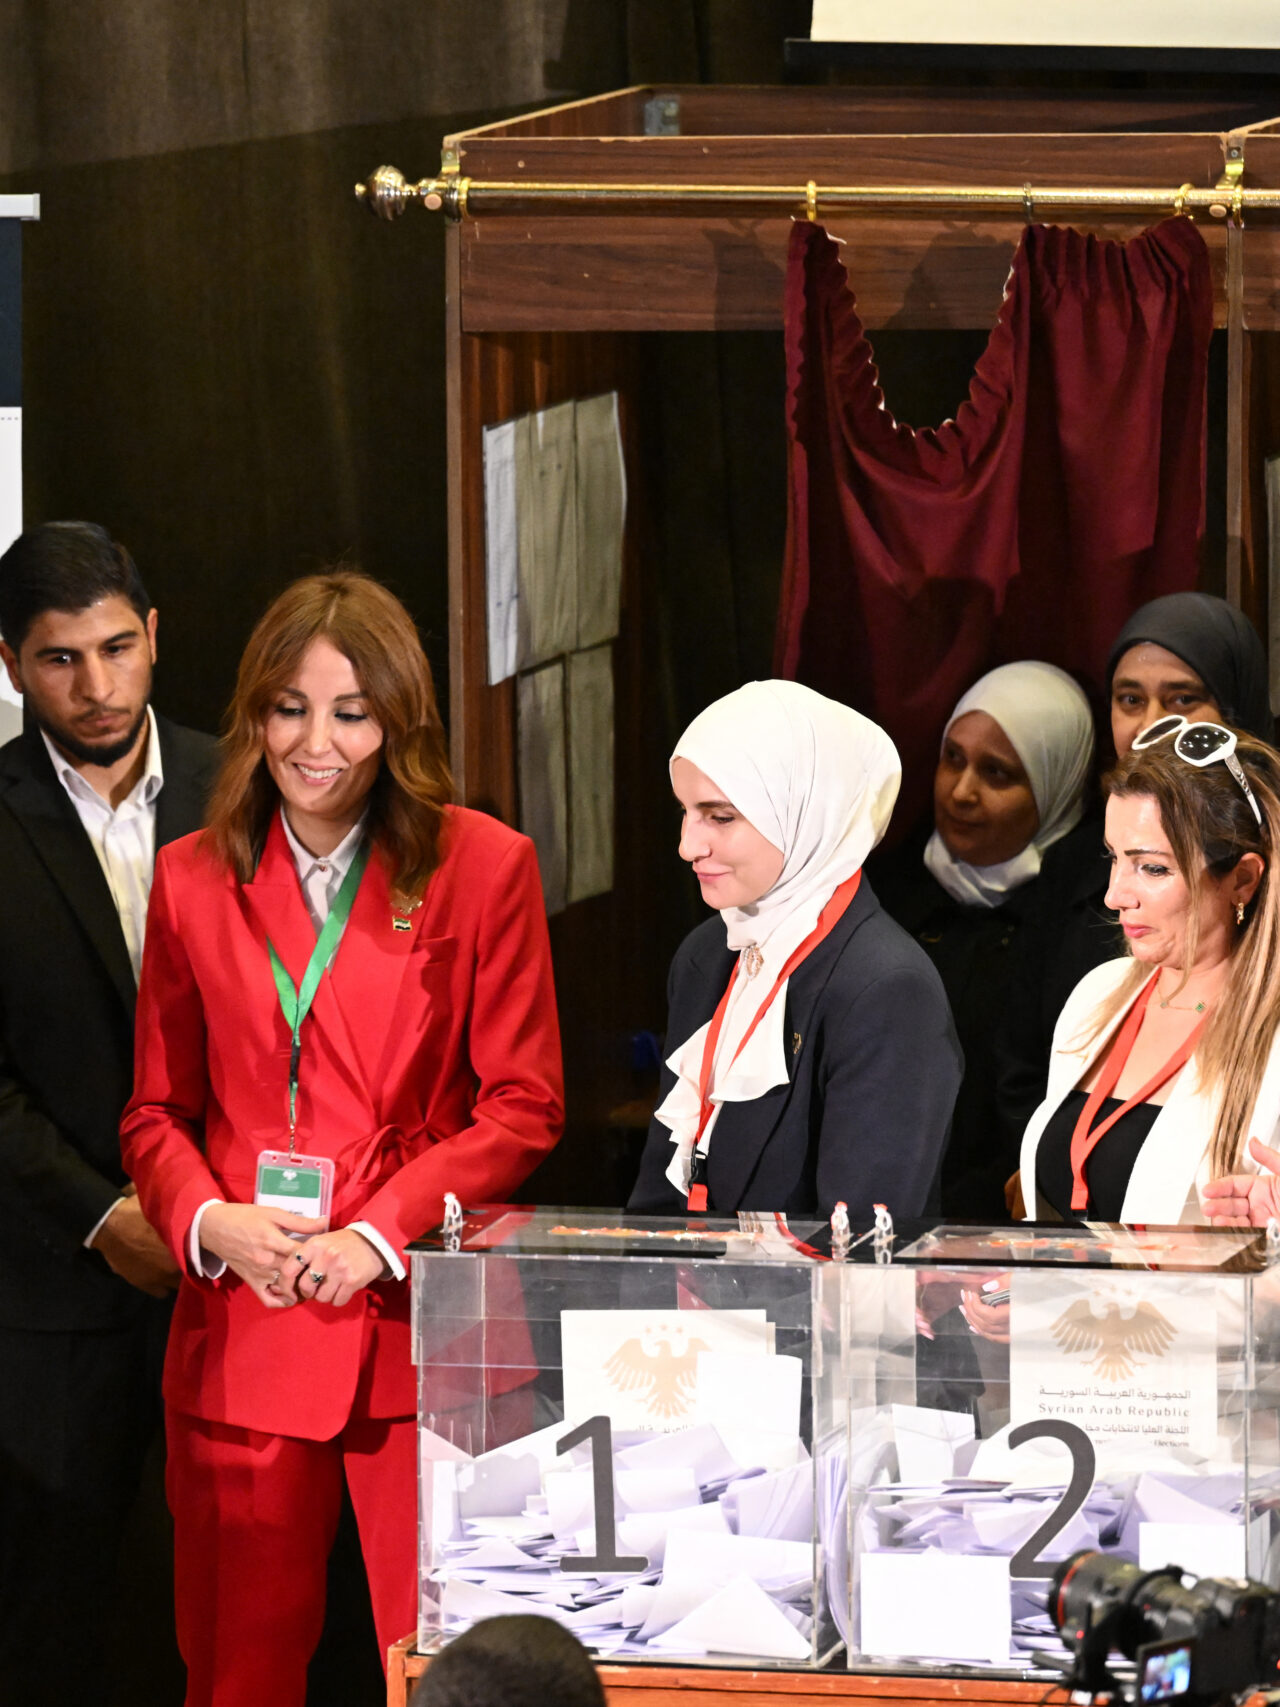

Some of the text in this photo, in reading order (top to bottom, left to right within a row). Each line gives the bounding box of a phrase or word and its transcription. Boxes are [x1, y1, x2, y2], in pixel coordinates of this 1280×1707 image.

[1038, 1402, 1190, 1418] Syrian Arab Republic
[556, 1415, 649, 1573] 1
[1008, 1419, 1096, 1578] 2
